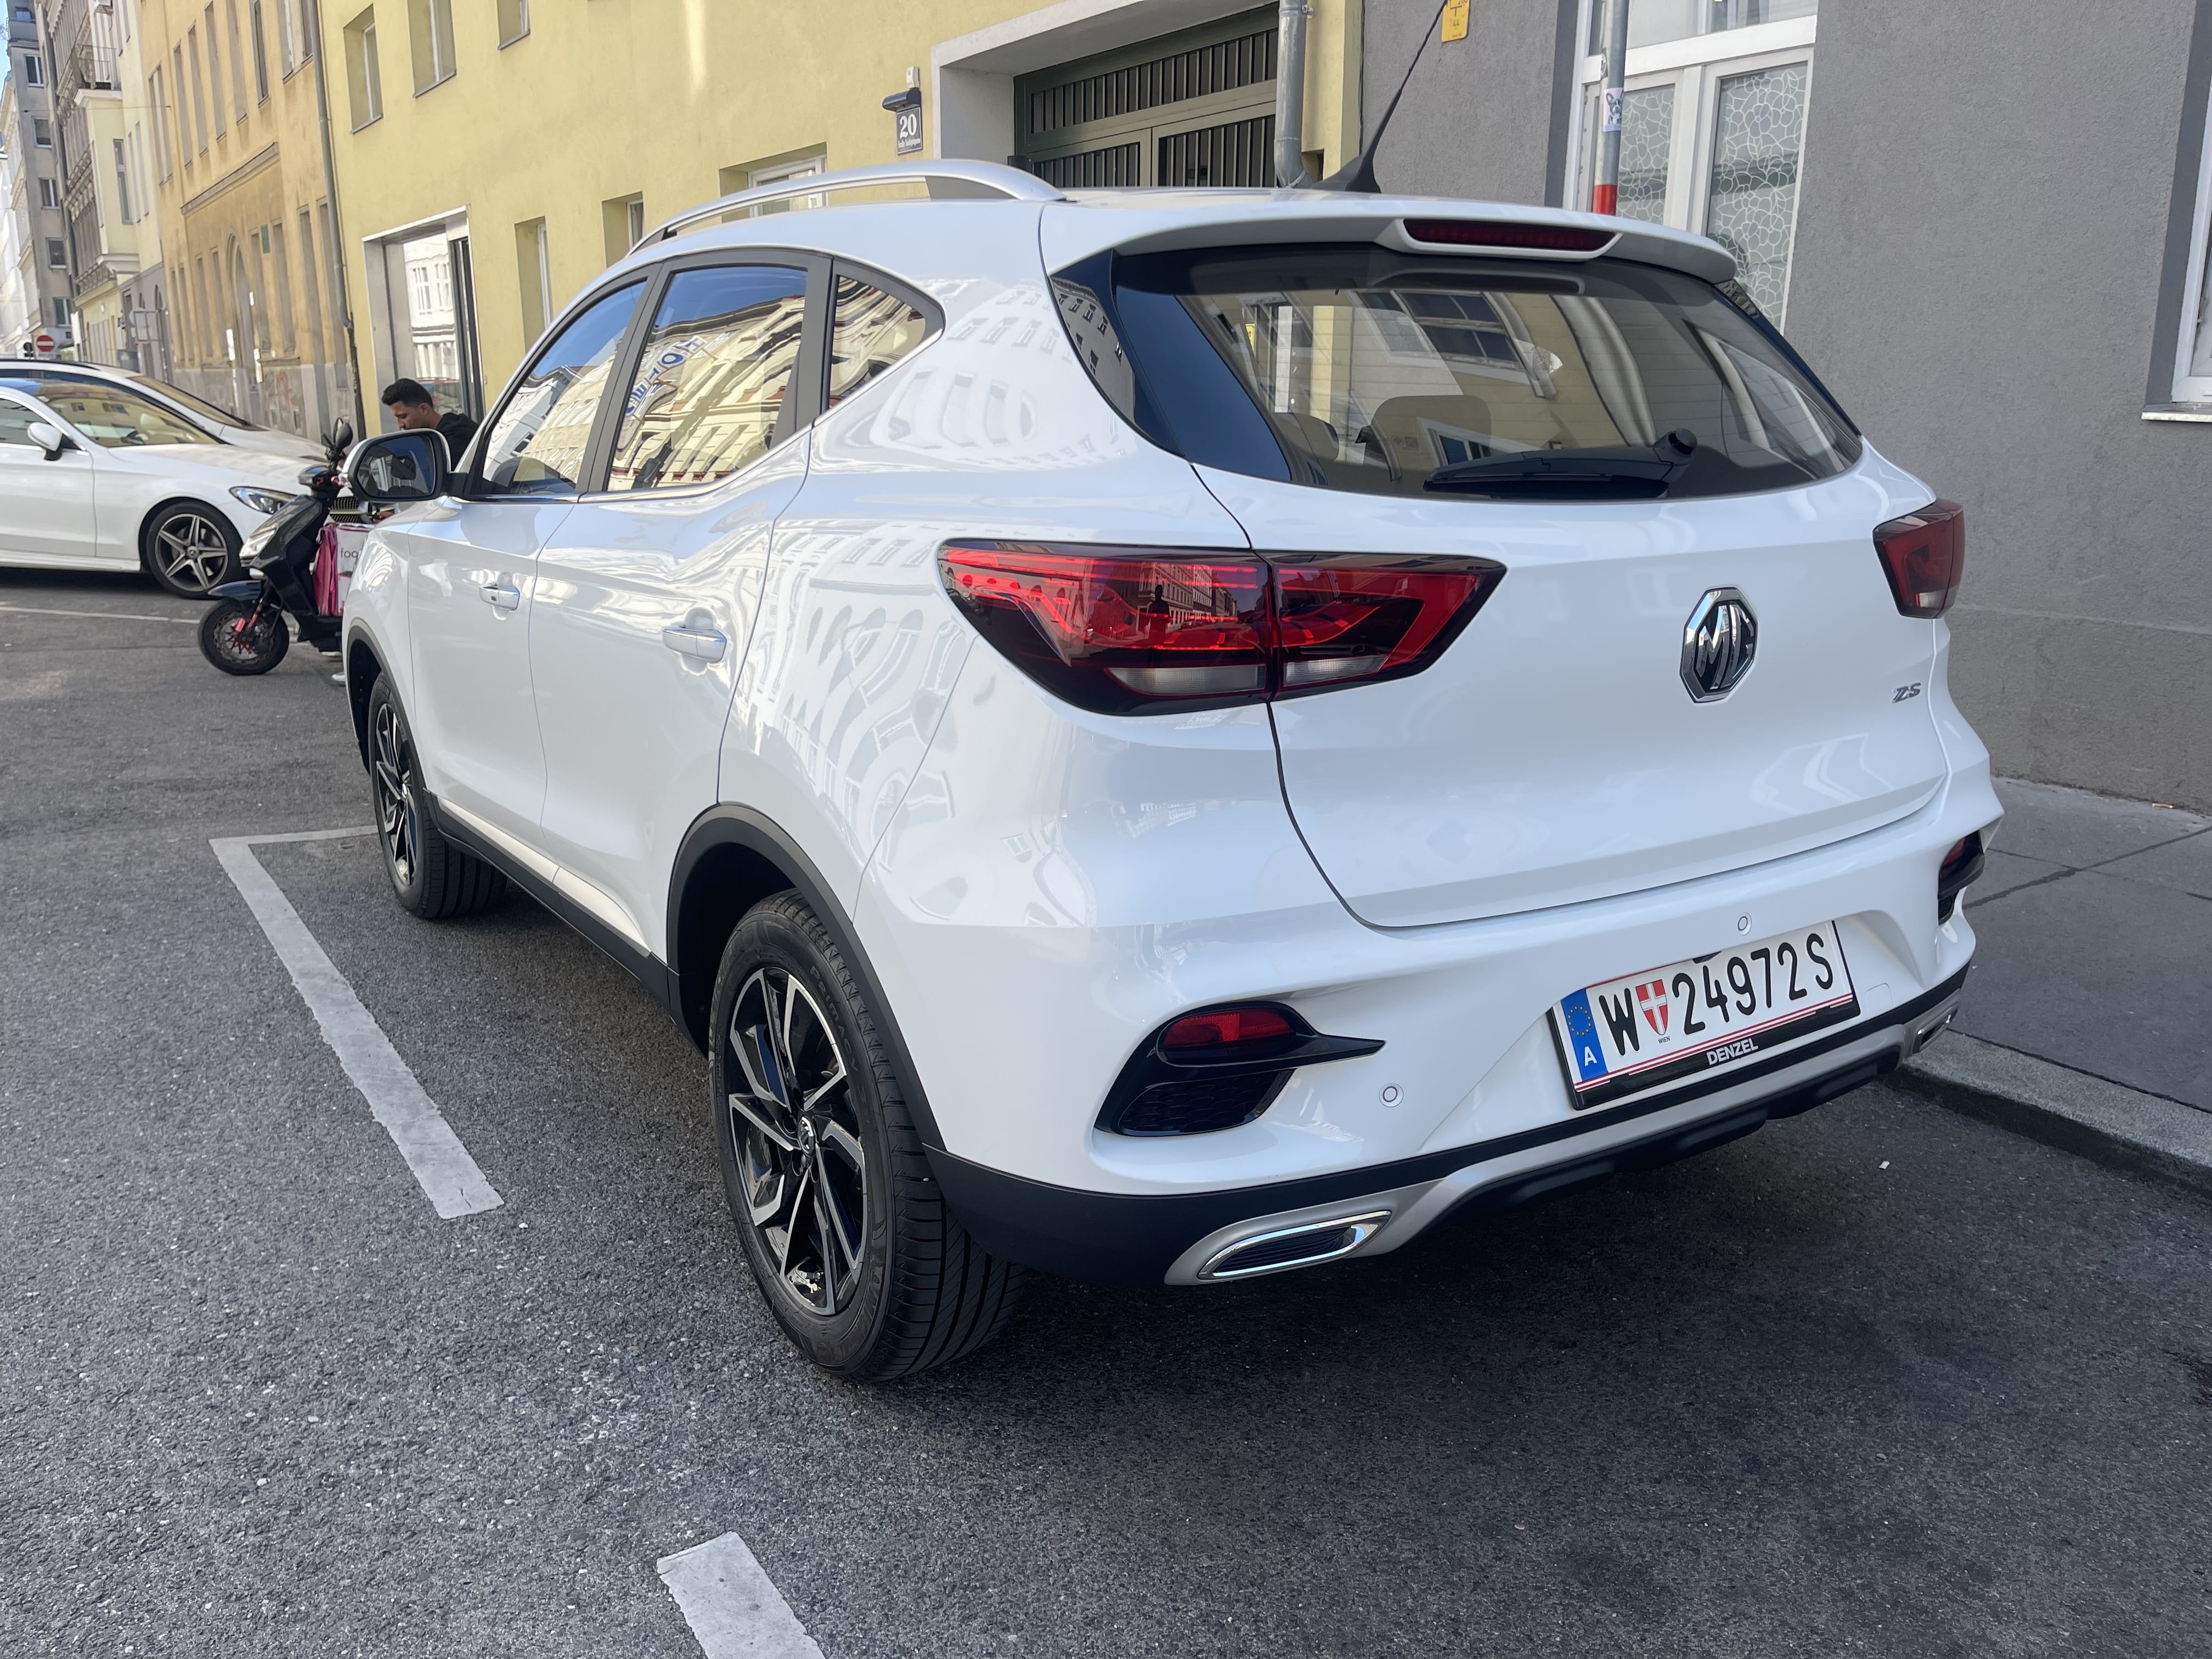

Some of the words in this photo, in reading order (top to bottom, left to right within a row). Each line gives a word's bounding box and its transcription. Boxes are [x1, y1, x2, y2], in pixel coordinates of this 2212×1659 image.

[900, 114, 917, 138] 20
[1892, 682, 1921, 703] ZS
[1599, 988, 1640, 1056] W
[1671, 933, 1833, 1035] 24972S
[1658, 1036, 1671, 1044] WIEN
[1584, 1046, 1598, 1066] A
[1706, 1038, 1759, 1066] DENZEL
